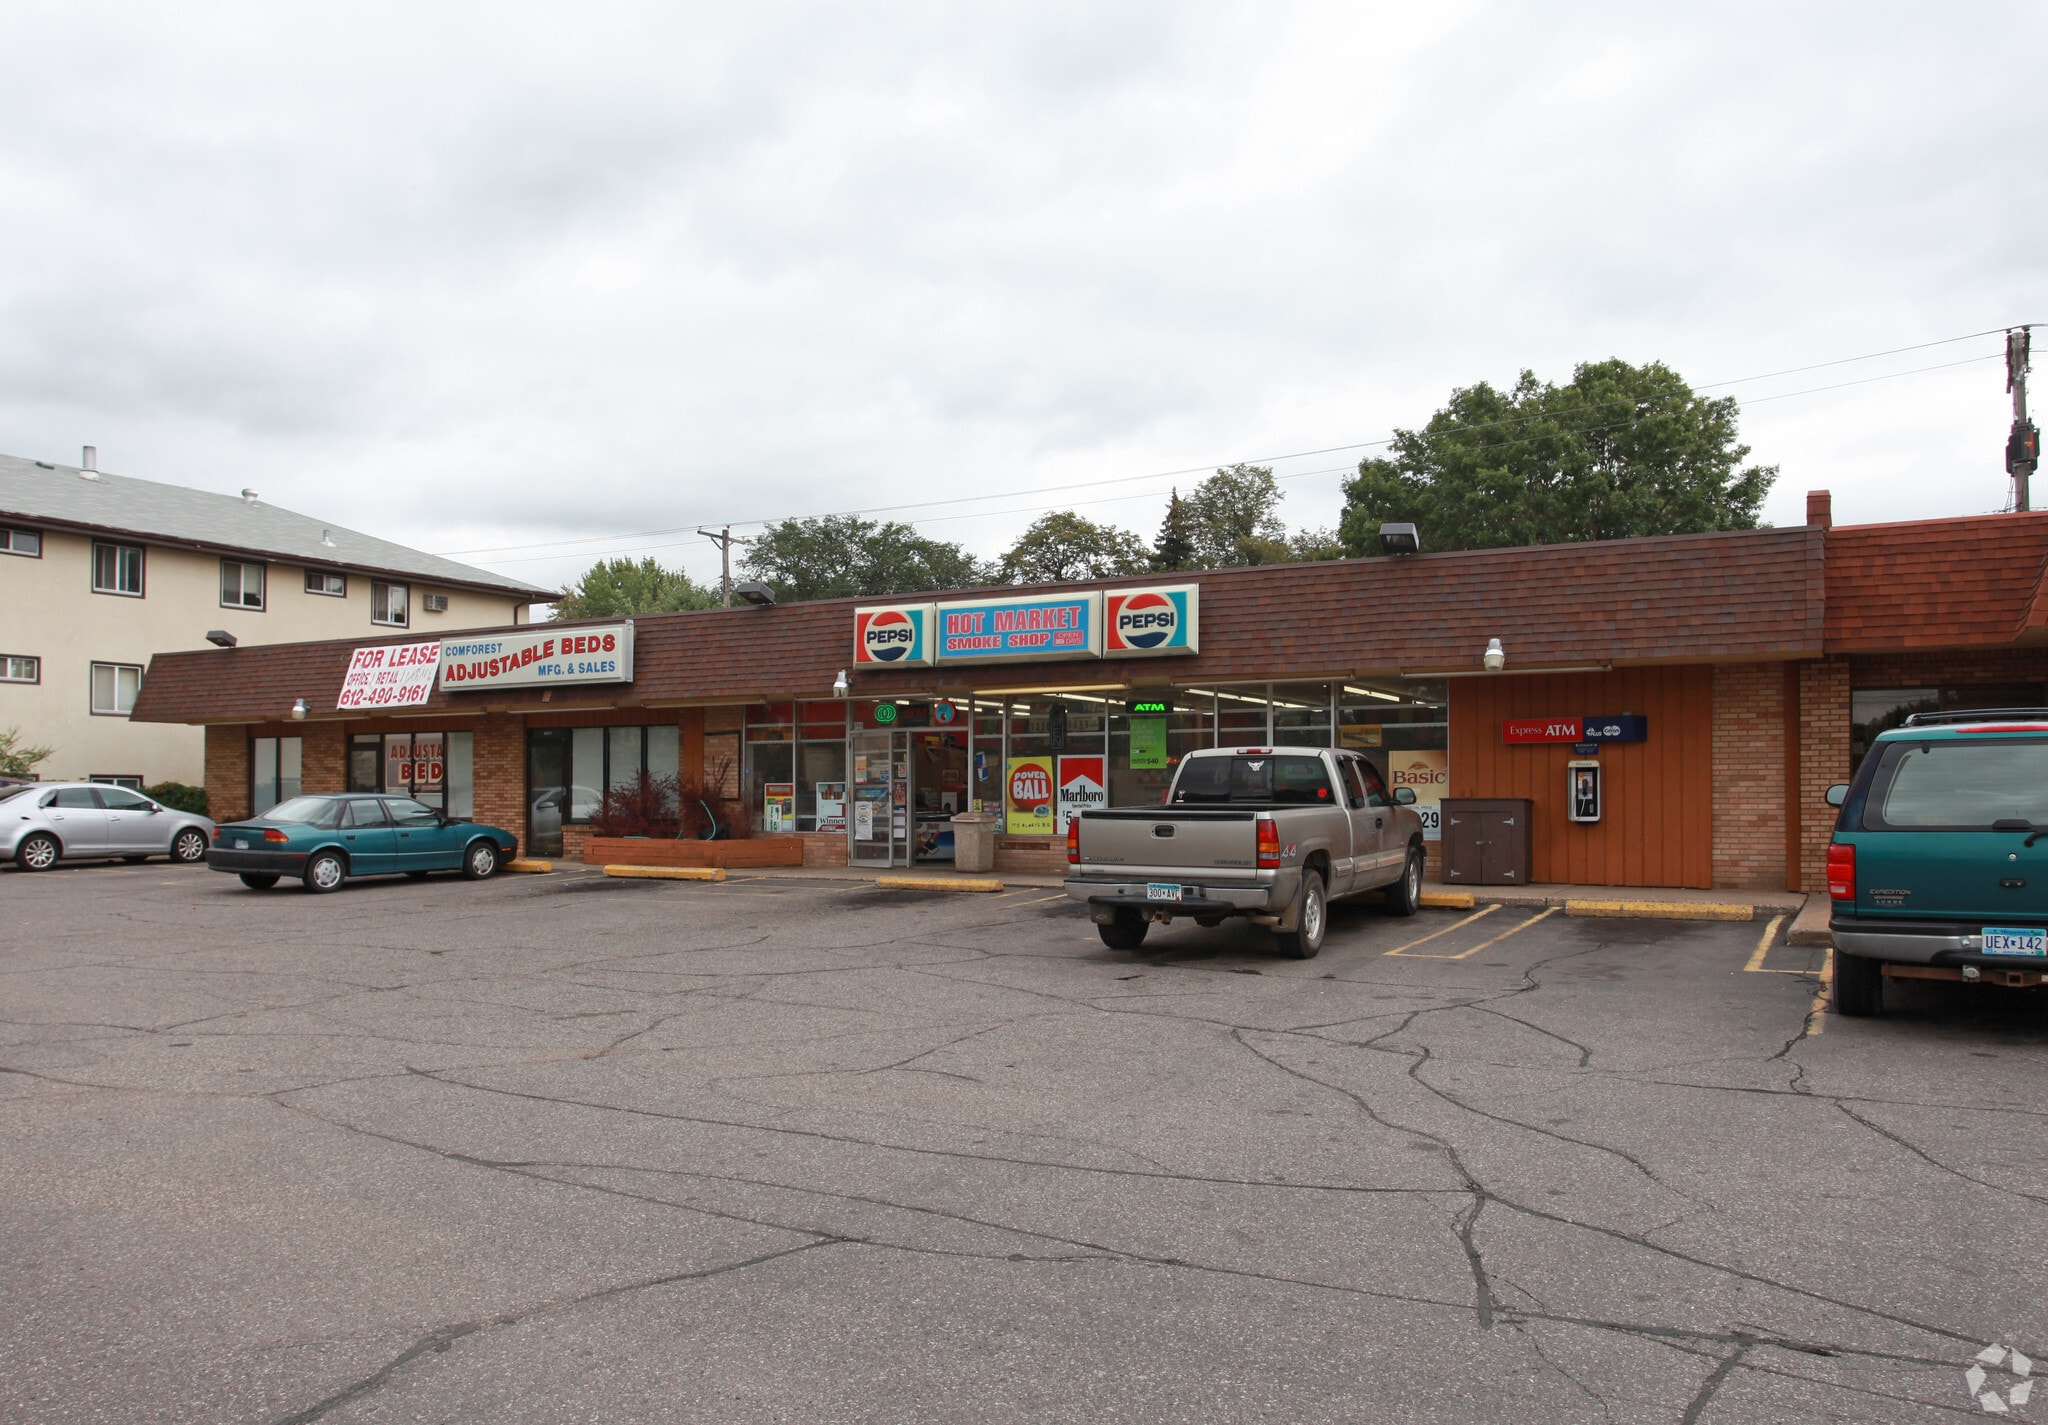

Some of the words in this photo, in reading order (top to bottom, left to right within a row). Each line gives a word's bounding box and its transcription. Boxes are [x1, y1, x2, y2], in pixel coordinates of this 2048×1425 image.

[947, 612, 985, 635] HOT
[994, 605, 1081, 632] MARKET
[1119, 611, 1175, 630] PEPSI
[866, 628, 913, 644] PEPSI
[947, 635, 1001, 651] SMOKE
[1008, 633, 1050, 647] SHOP
[1058, 631, 1079, 639] OPEN
[353, 649, 385, 669] FOR
[388, 644, 440, 668] LEASE
[445, 643, 503, 657] COMFOREST
[445, 639, 555, 682] ADJUSTABLE
[561, 634, 616, 655] BEDS
[537, 664, 565, 677] MFG.
[567, 662, 575, 675] &
[578, 661, 616, 674] SALES
[347, 672, 371, 687] OFFICE
[375, 670, 400, 685] RETAIL
[340, 684, 428, 705] 612-490-9161
[1134, 703, 1165, 711] ATM
[1510, 725, 1543, 737] Express
[1545, 724, 1576, 737] ATM
[1014, 771, 1047, 781] POWER
[1393, 769, 1446, 784] Basic
[1013, 779, 1049, 800] BALL
[1060, 785, 1104, 802] Marlboro
[1421, 811, 1439, 829] 29
[1985, 935, 2010, 949] UEX
[2017, 936, 2042, 950] 142
